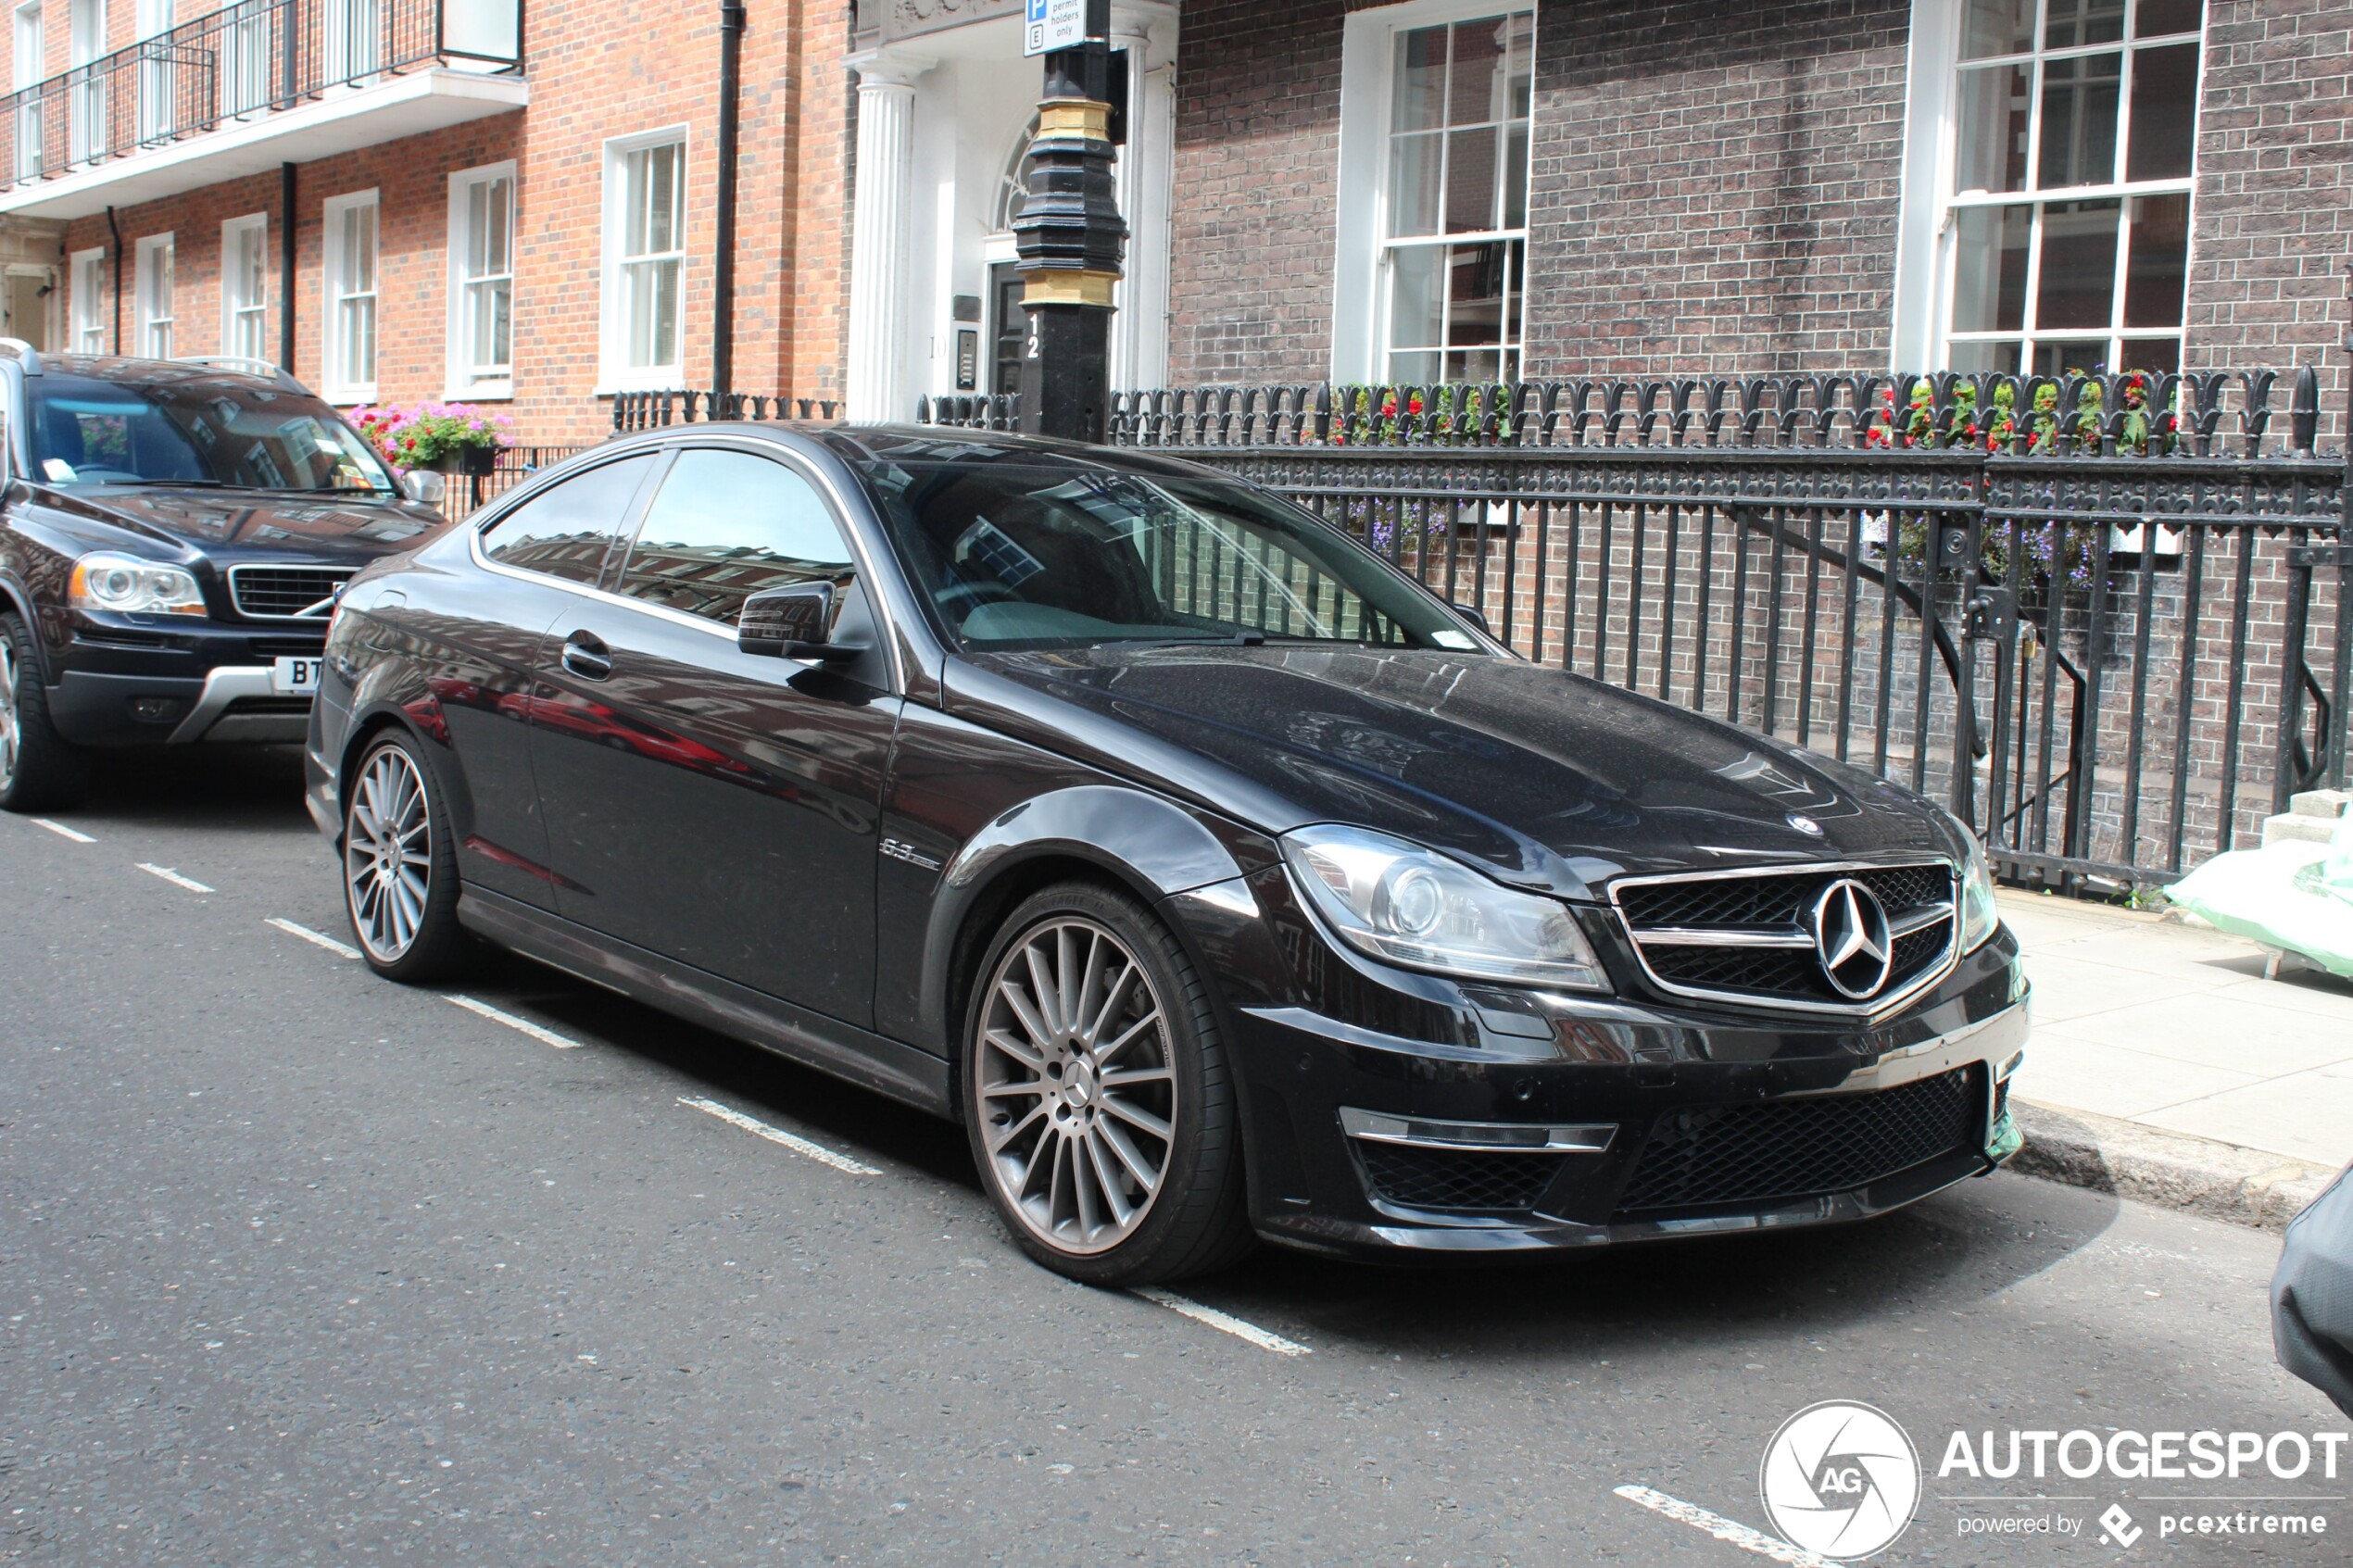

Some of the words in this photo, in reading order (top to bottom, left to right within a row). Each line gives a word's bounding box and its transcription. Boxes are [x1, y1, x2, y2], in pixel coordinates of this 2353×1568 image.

[1052, 0, 1077, 13] permit
[1051, 11, 1079, 25] holders
[1034, 31, 1039, 43] E
[1057, 25, 1073, 37] only
